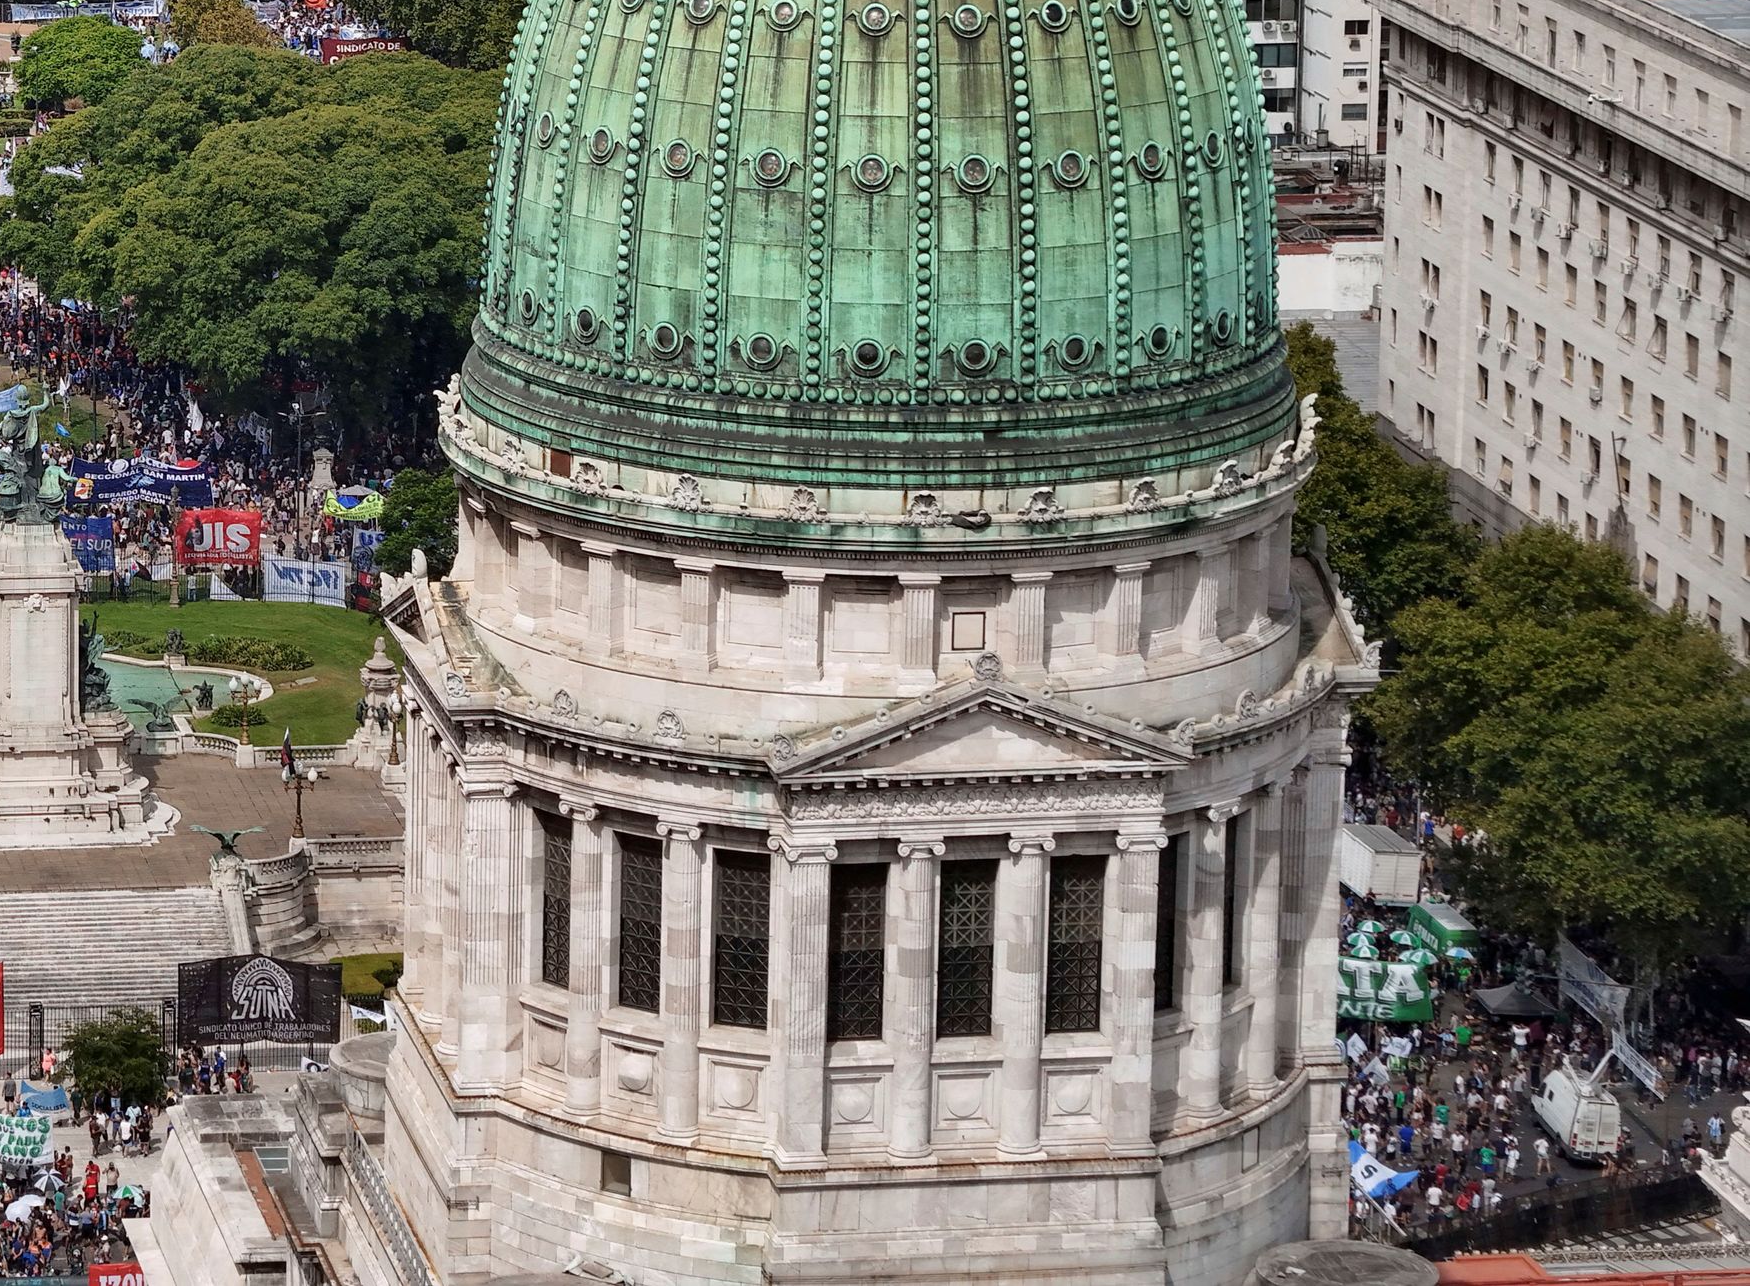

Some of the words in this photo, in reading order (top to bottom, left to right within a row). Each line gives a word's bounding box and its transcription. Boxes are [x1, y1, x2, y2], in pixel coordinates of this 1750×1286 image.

[84, 468, 141, 480] SECCIONAL
[143, 469, 164, 480] SAN
[166, 472, 206, 482] MARTIN
[98, 488, 138, 500] GERARDO
[110, 494, 166, 506] CONDUCCION
[192, 522, 252, 553] JIS
[86, 539, 113, 551] SUR
[231, 985, 296, 1020] SUTNA
[198, 1023, 238, 1034] SINDICATO
[264, 1021, 273, 1031] DE
[274, 1022, 332, 1033] TRABAJADORES
[214, 1031, 229, 1040] DEL
[30, 1101, 68, 1112] SOCIALISTA
[7, 1133, 47, 1147] PABLO
